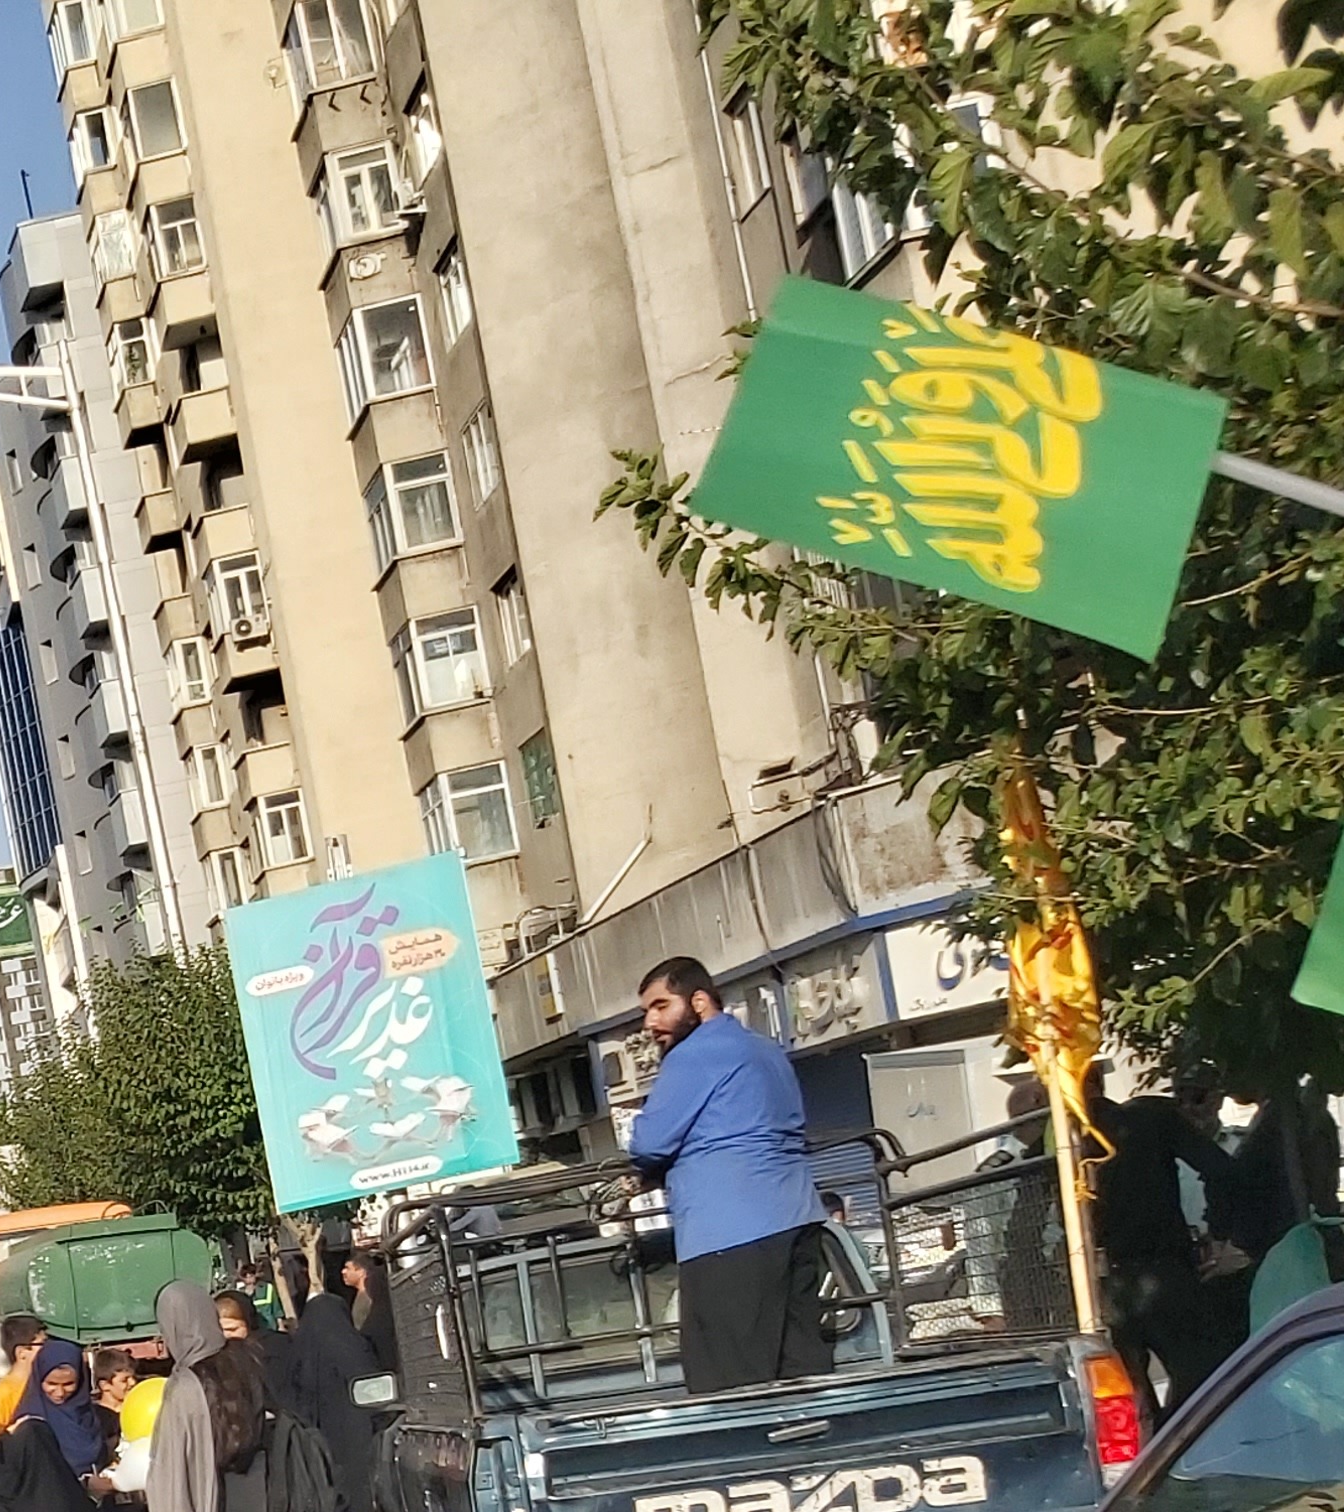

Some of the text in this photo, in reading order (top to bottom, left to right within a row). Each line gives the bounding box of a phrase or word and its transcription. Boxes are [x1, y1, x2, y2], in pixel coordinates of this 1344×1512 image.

[289, 882, 400, 1080] قرآن
[388, 932, 442, 954] همایش
[327, 976, 435, 1078] غدیر
